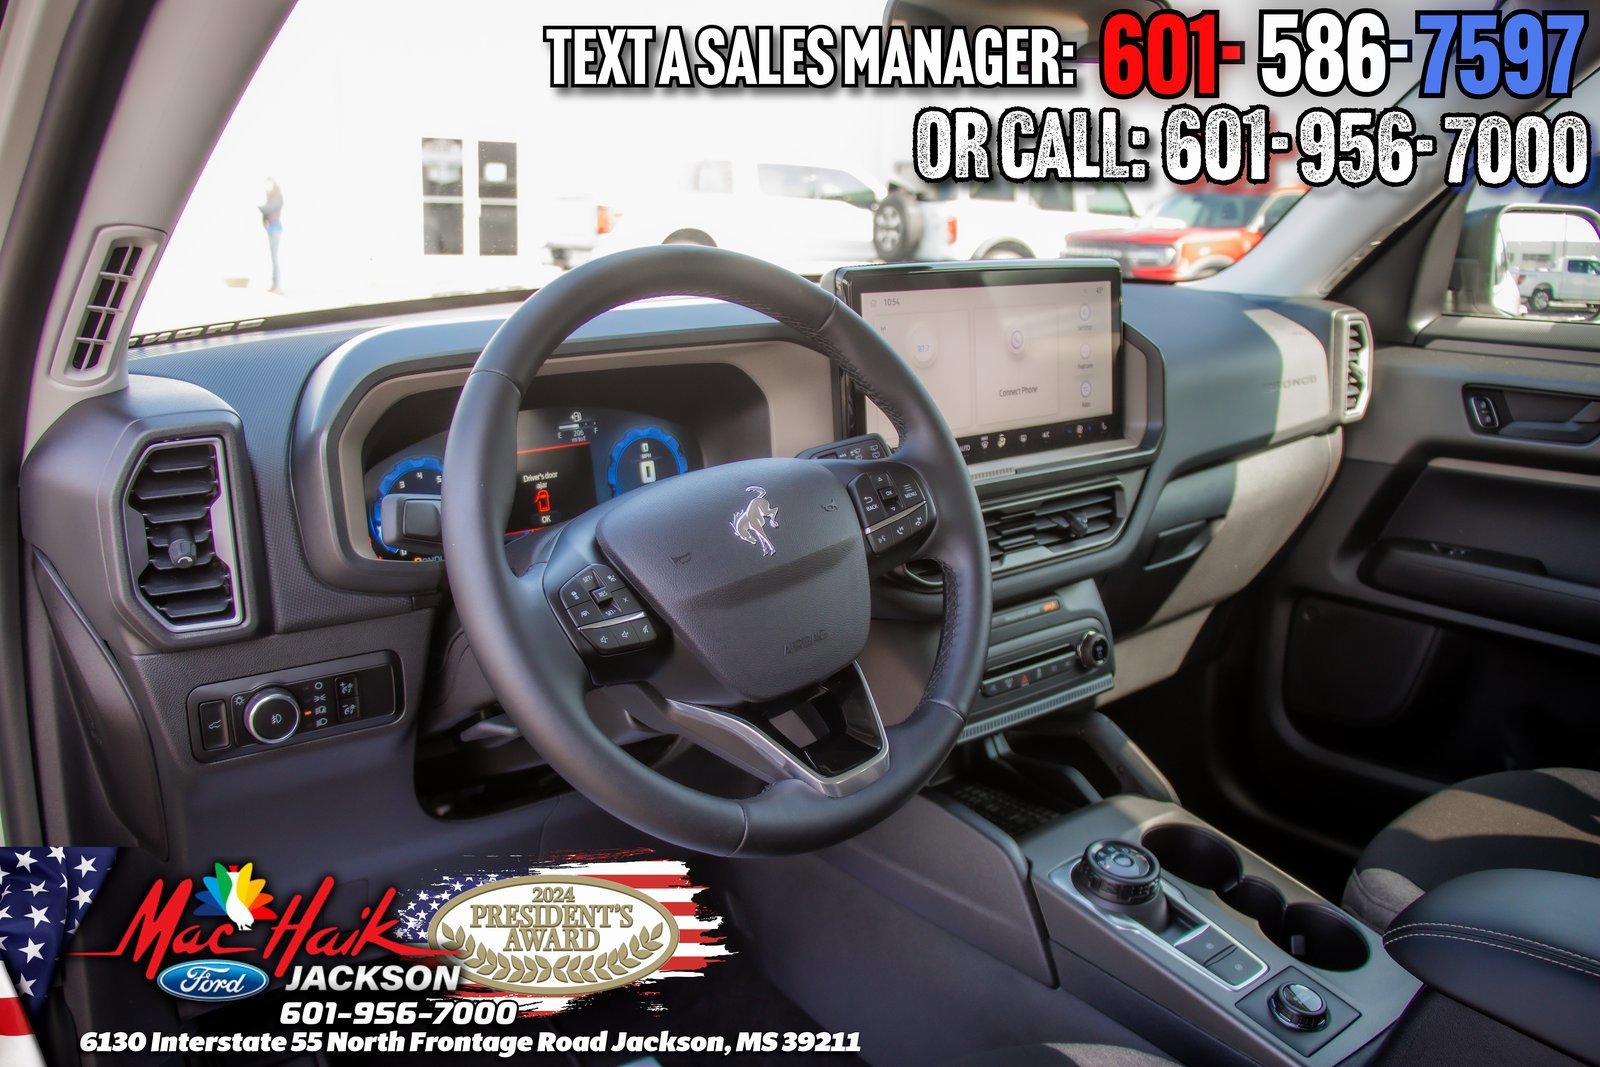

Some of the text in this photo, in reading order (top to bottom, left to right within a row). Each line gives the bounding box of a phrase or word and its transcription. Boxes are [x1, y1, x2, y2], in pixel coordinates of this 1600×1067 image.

[640, 460, 657, 484] 0
[523, 472, 558, 483] Driver's door
[905, 491, 918, 499] MENU
[866, 504, 879, 512] BACK
[541, 515, 552, 523] OK
